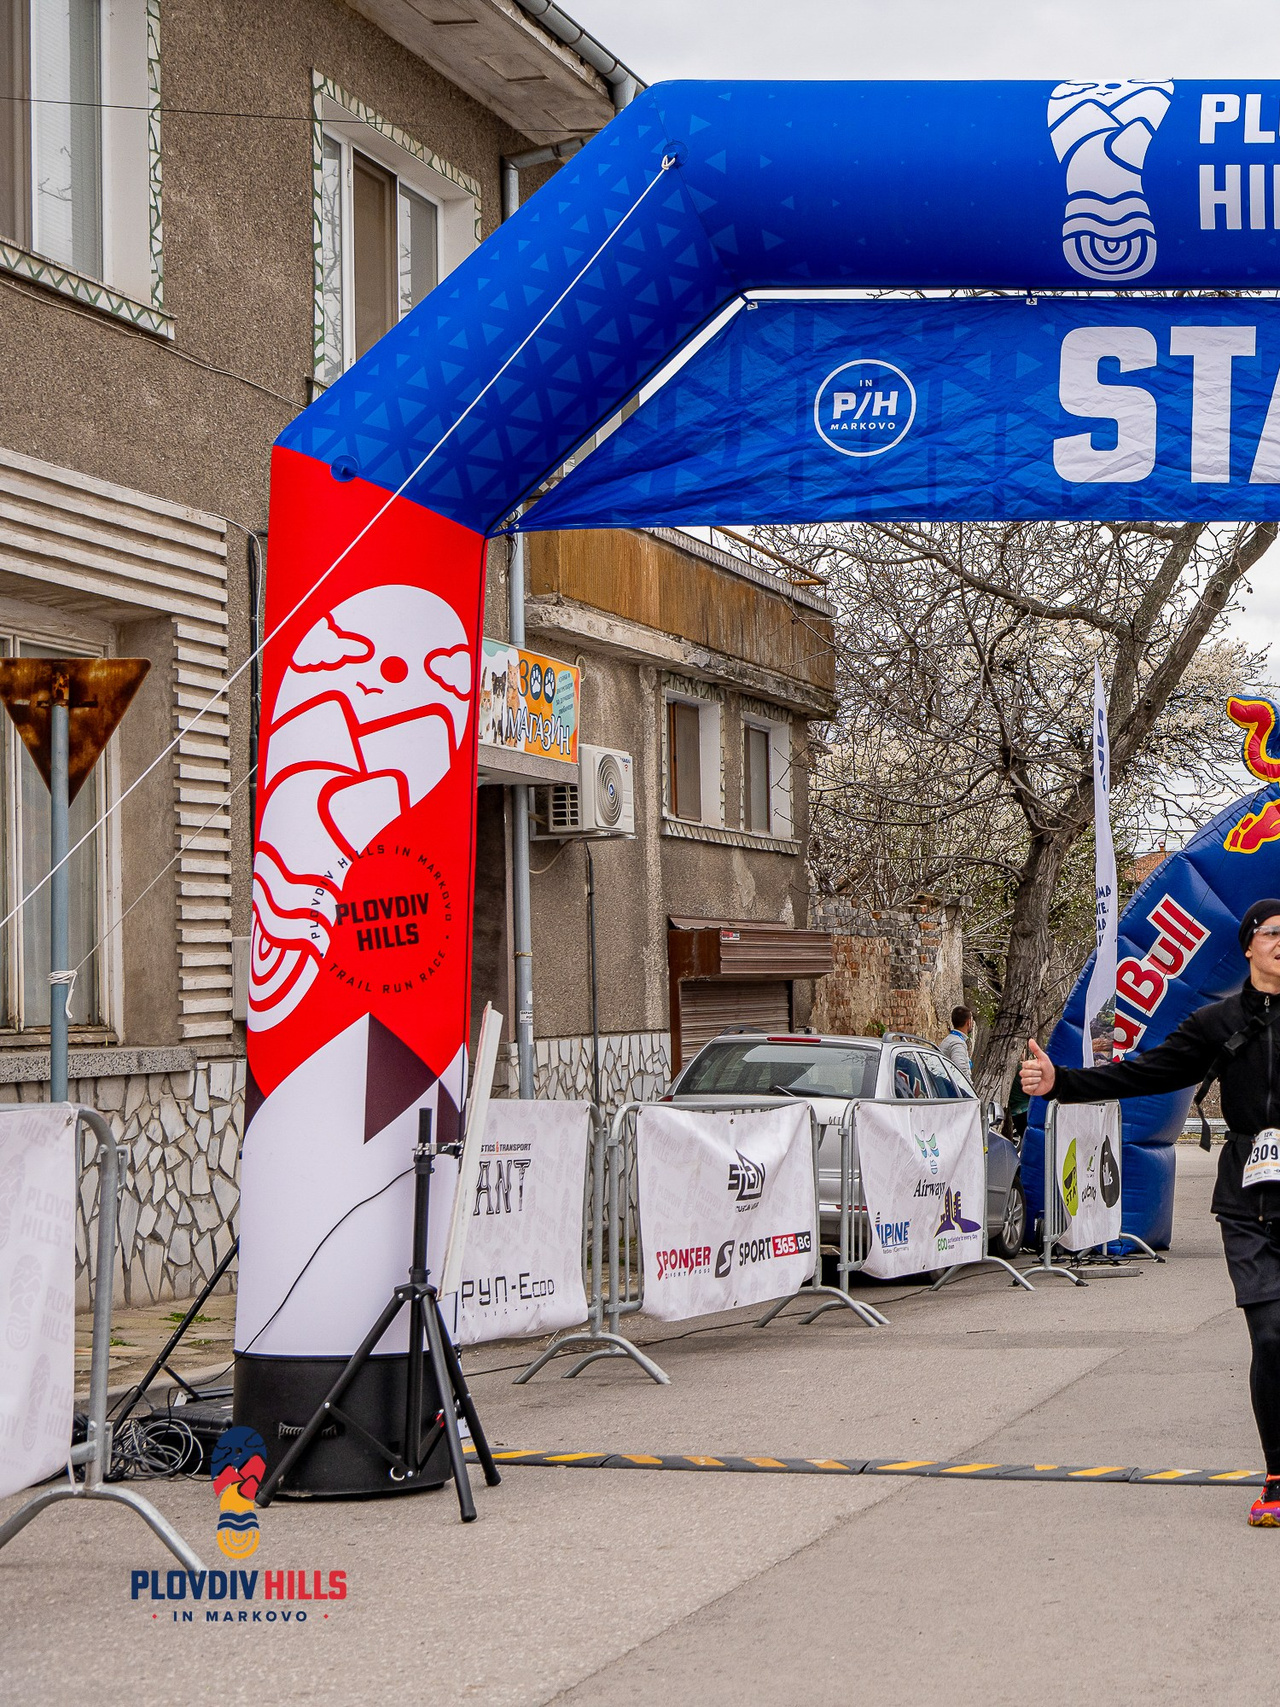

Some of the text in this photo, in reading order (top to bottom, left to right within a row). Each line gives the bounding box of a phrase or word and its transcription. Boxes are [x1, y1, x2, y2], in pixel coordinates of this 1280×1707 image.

[859, 379, 873, 388] IN
[832, 390, 898, 420] P/H
[829, 422, 896, 431] MARKOVO
[506, 706, 571, 755] МАГАЗИН
[334, 892, 429, 926] PLOVDIV
[356, 922, 420, 952] HILLS
[328, 950, 446, 994] TRAIL RUN RACE
[1116, 898, 1206, 1013] Bull
[499, 1143, 531, 1152] TRANSPORT
[473, 1159, 531, 1216] ANT
[656, 1246, 712, 1281] SPONSER
